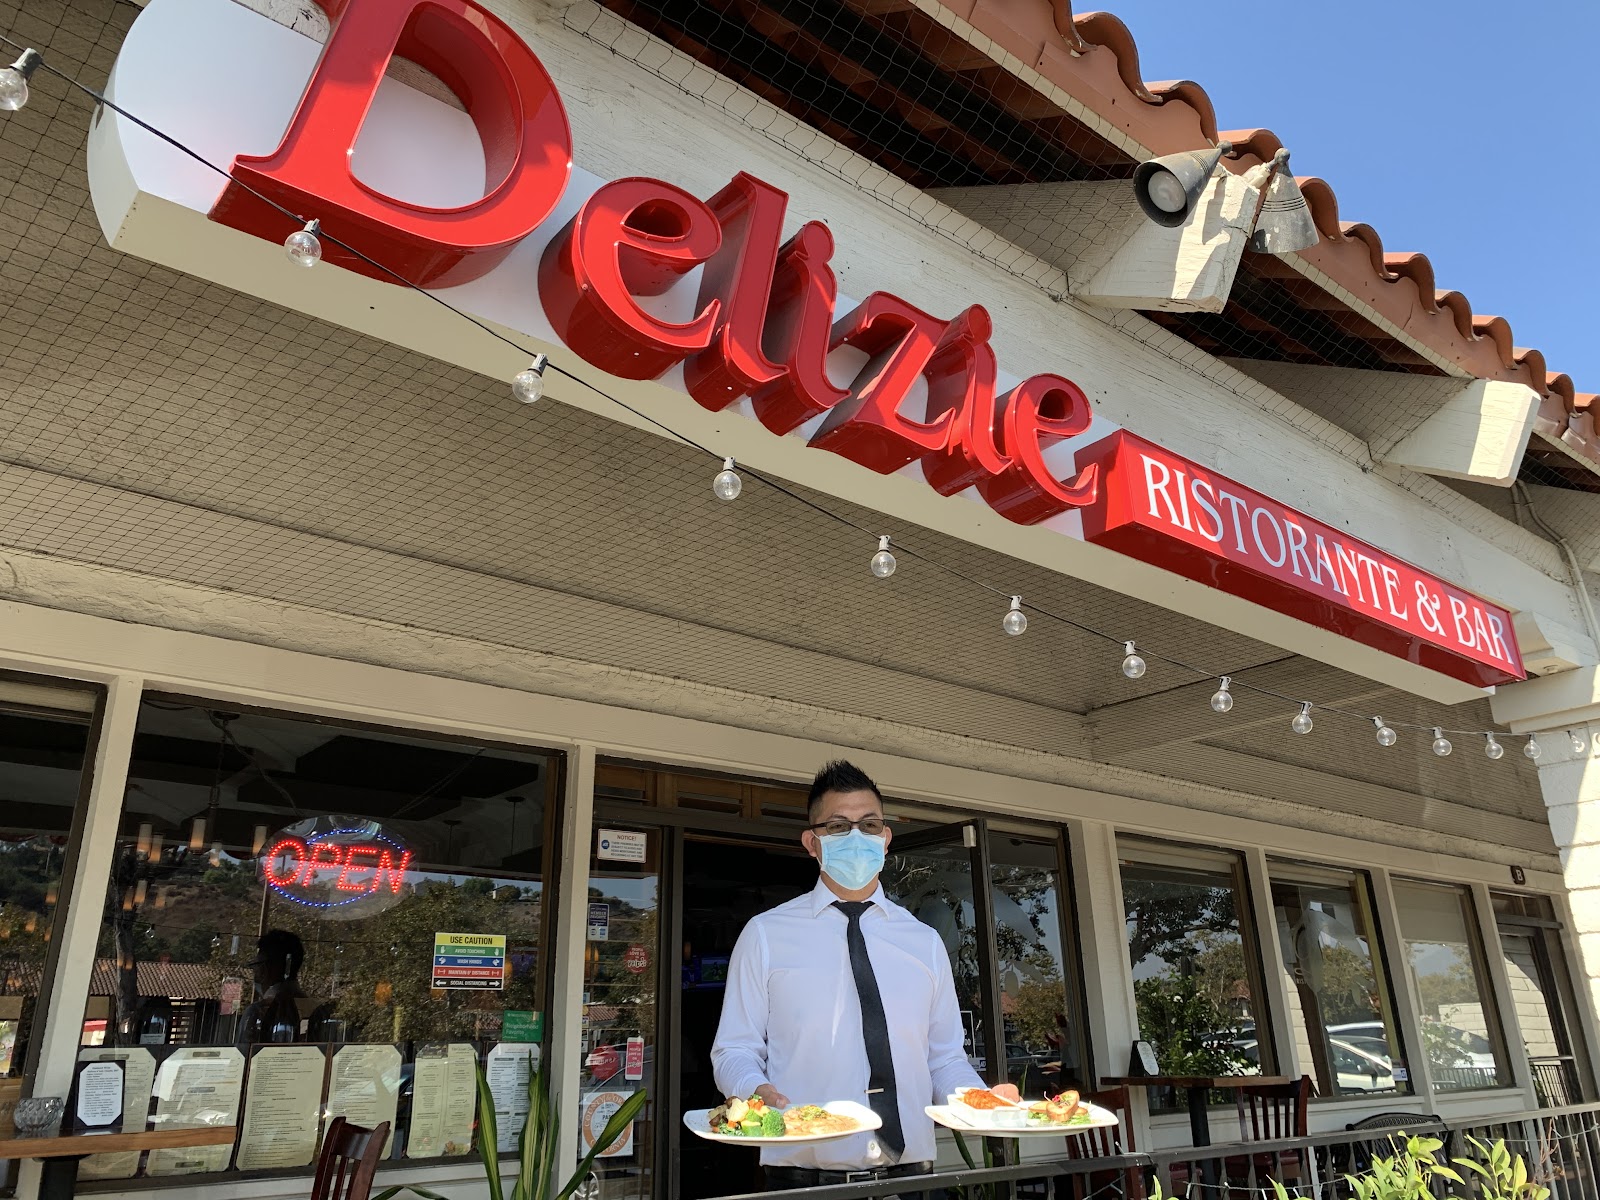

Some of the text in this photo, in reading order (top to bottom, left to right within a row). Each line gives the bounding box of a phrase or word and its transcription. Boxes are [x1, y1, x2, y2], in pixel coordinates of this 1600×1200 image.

[216, 0, 1099, 516] Delizie
[1139, 453, 1515, 665] RISTORANTE & BAR
[264, 838, 412, 894] OPEN
[1515, 869, 1523, 881] B
[450, 936, 493, 945] USE CAUTION
